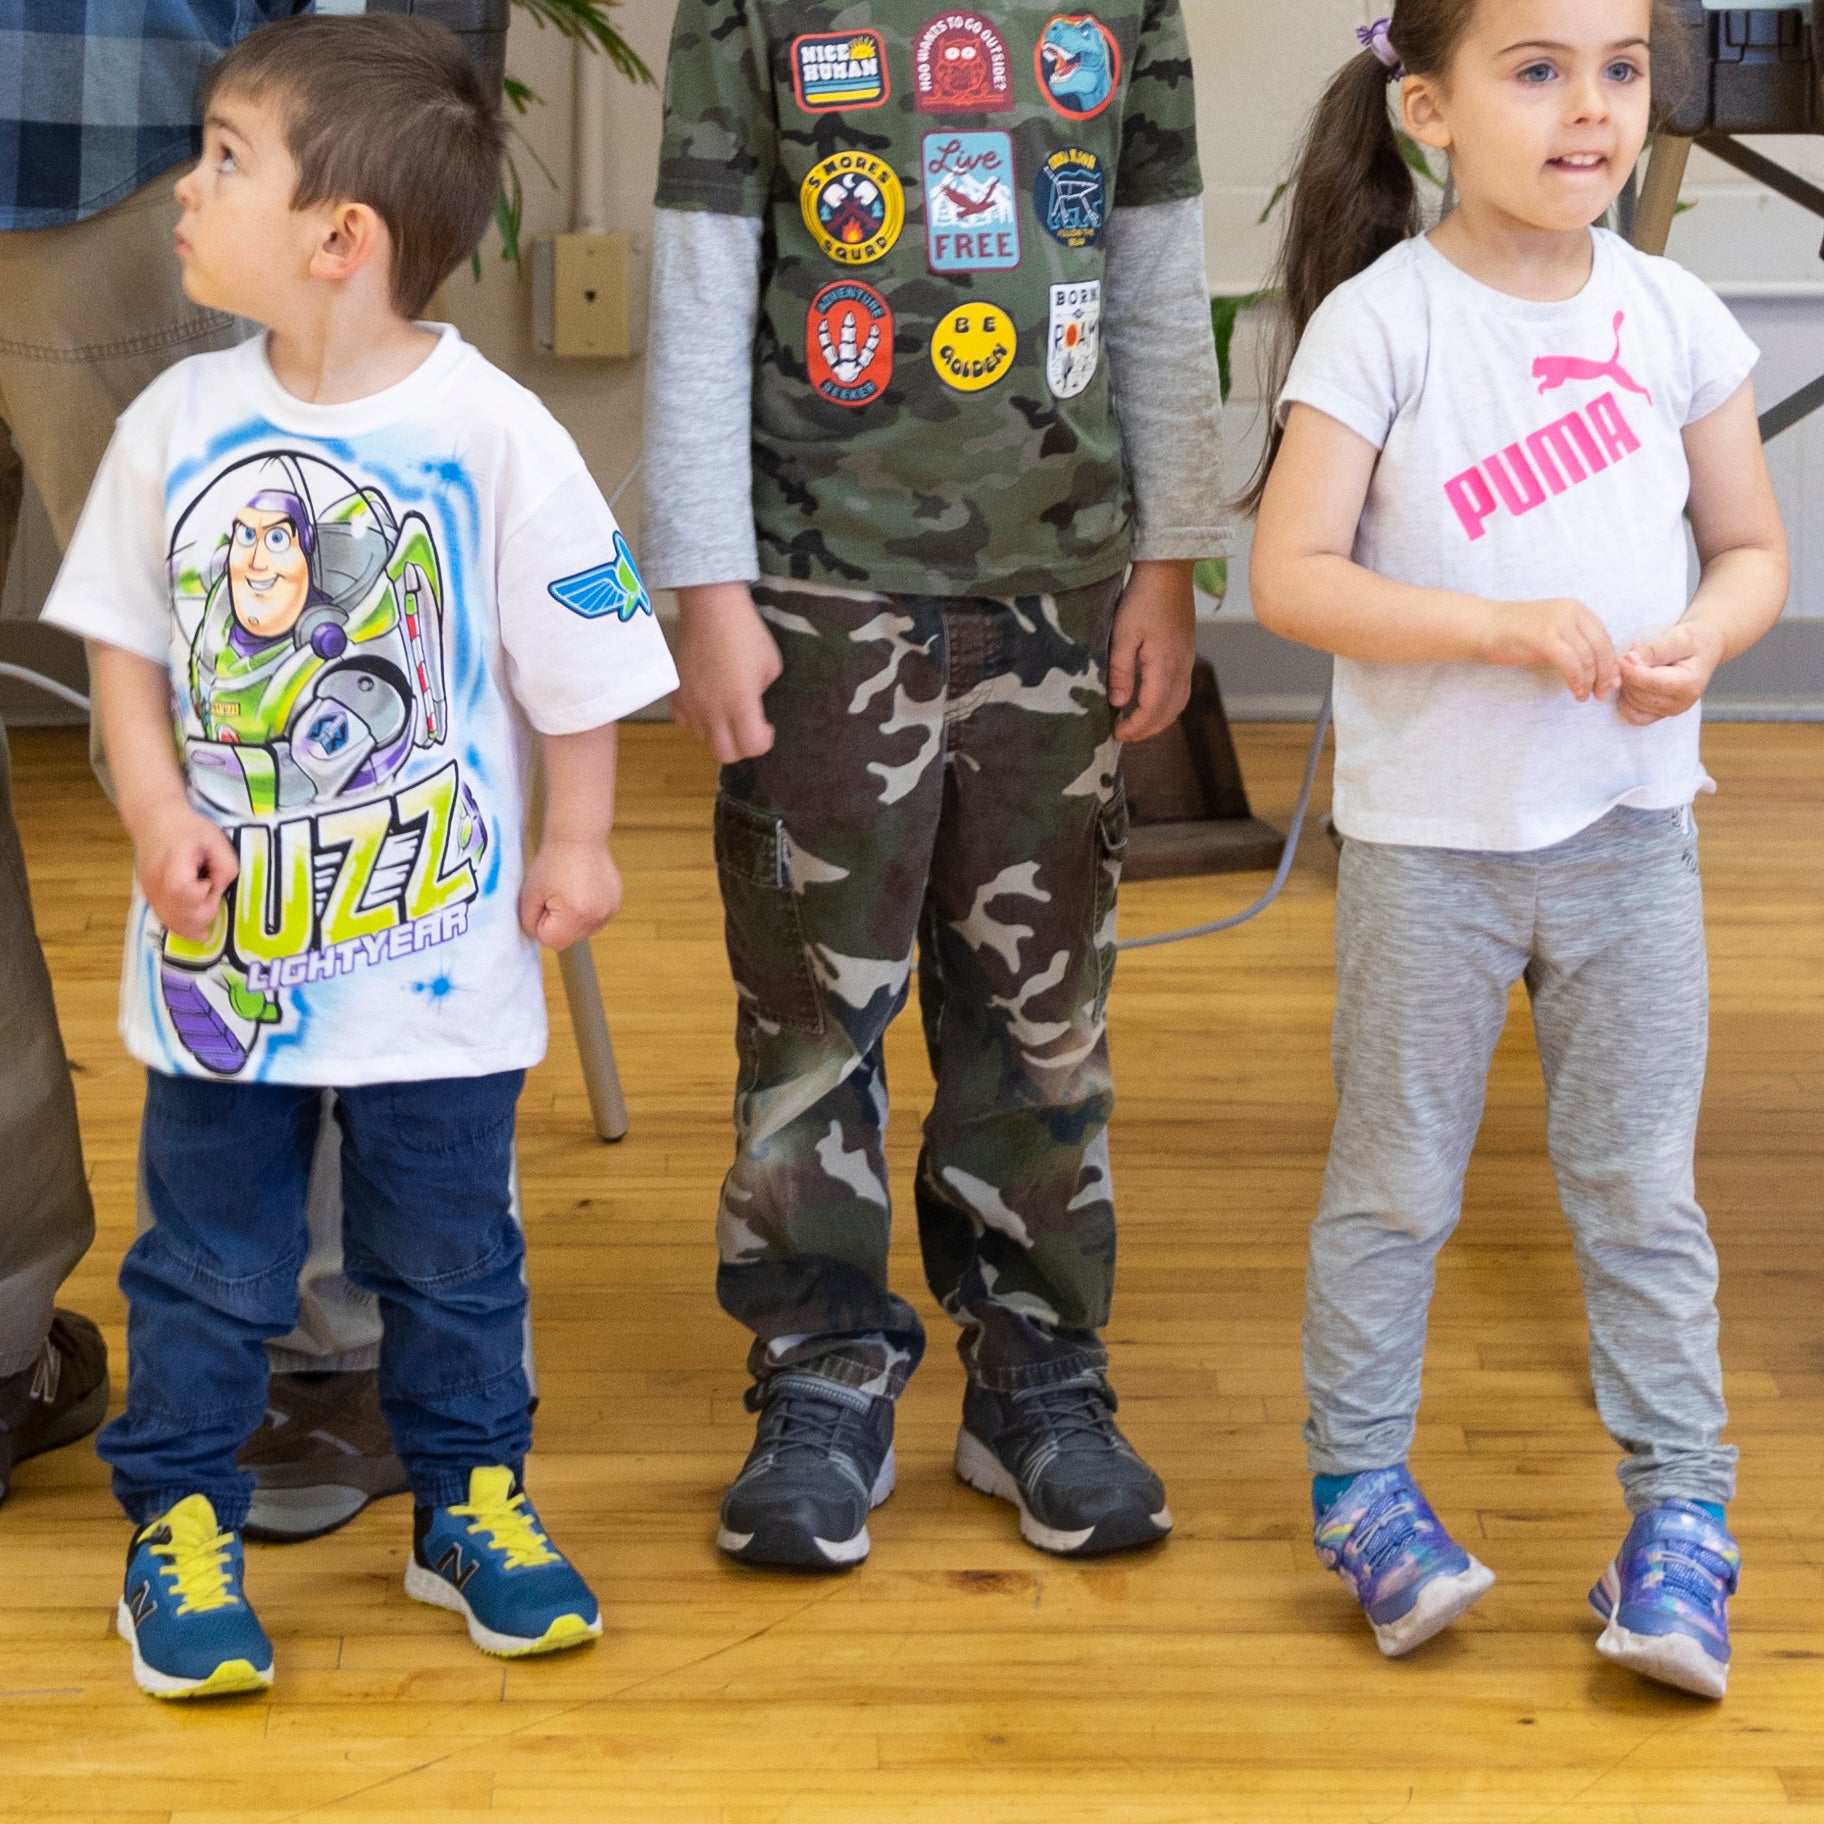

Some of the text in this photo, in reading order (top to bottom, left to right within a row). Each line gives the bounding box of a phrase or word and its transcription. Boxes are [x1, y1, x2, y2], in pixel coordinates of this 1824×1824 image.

[800, 43, 851, 65] NICE
[802, 57, 879, 83] HUMAN
[916, 15, 1007, 92] HOO WANTS TO GO OUTSIDE?
[928, 139, 1003, 176] Live
[824, 236, 888, 261] SQUAD
[934, 231, 1015, 260] FREE
[817, 286, 885, 320] ADVENTURE
[939, 342, 1008, 378] GOLDEN
[820, 379, 878, 402] SEEKER
[1443, 390, 1642, 543] PUMA
[245, 900, 470, 993] LIGHTYEAR
